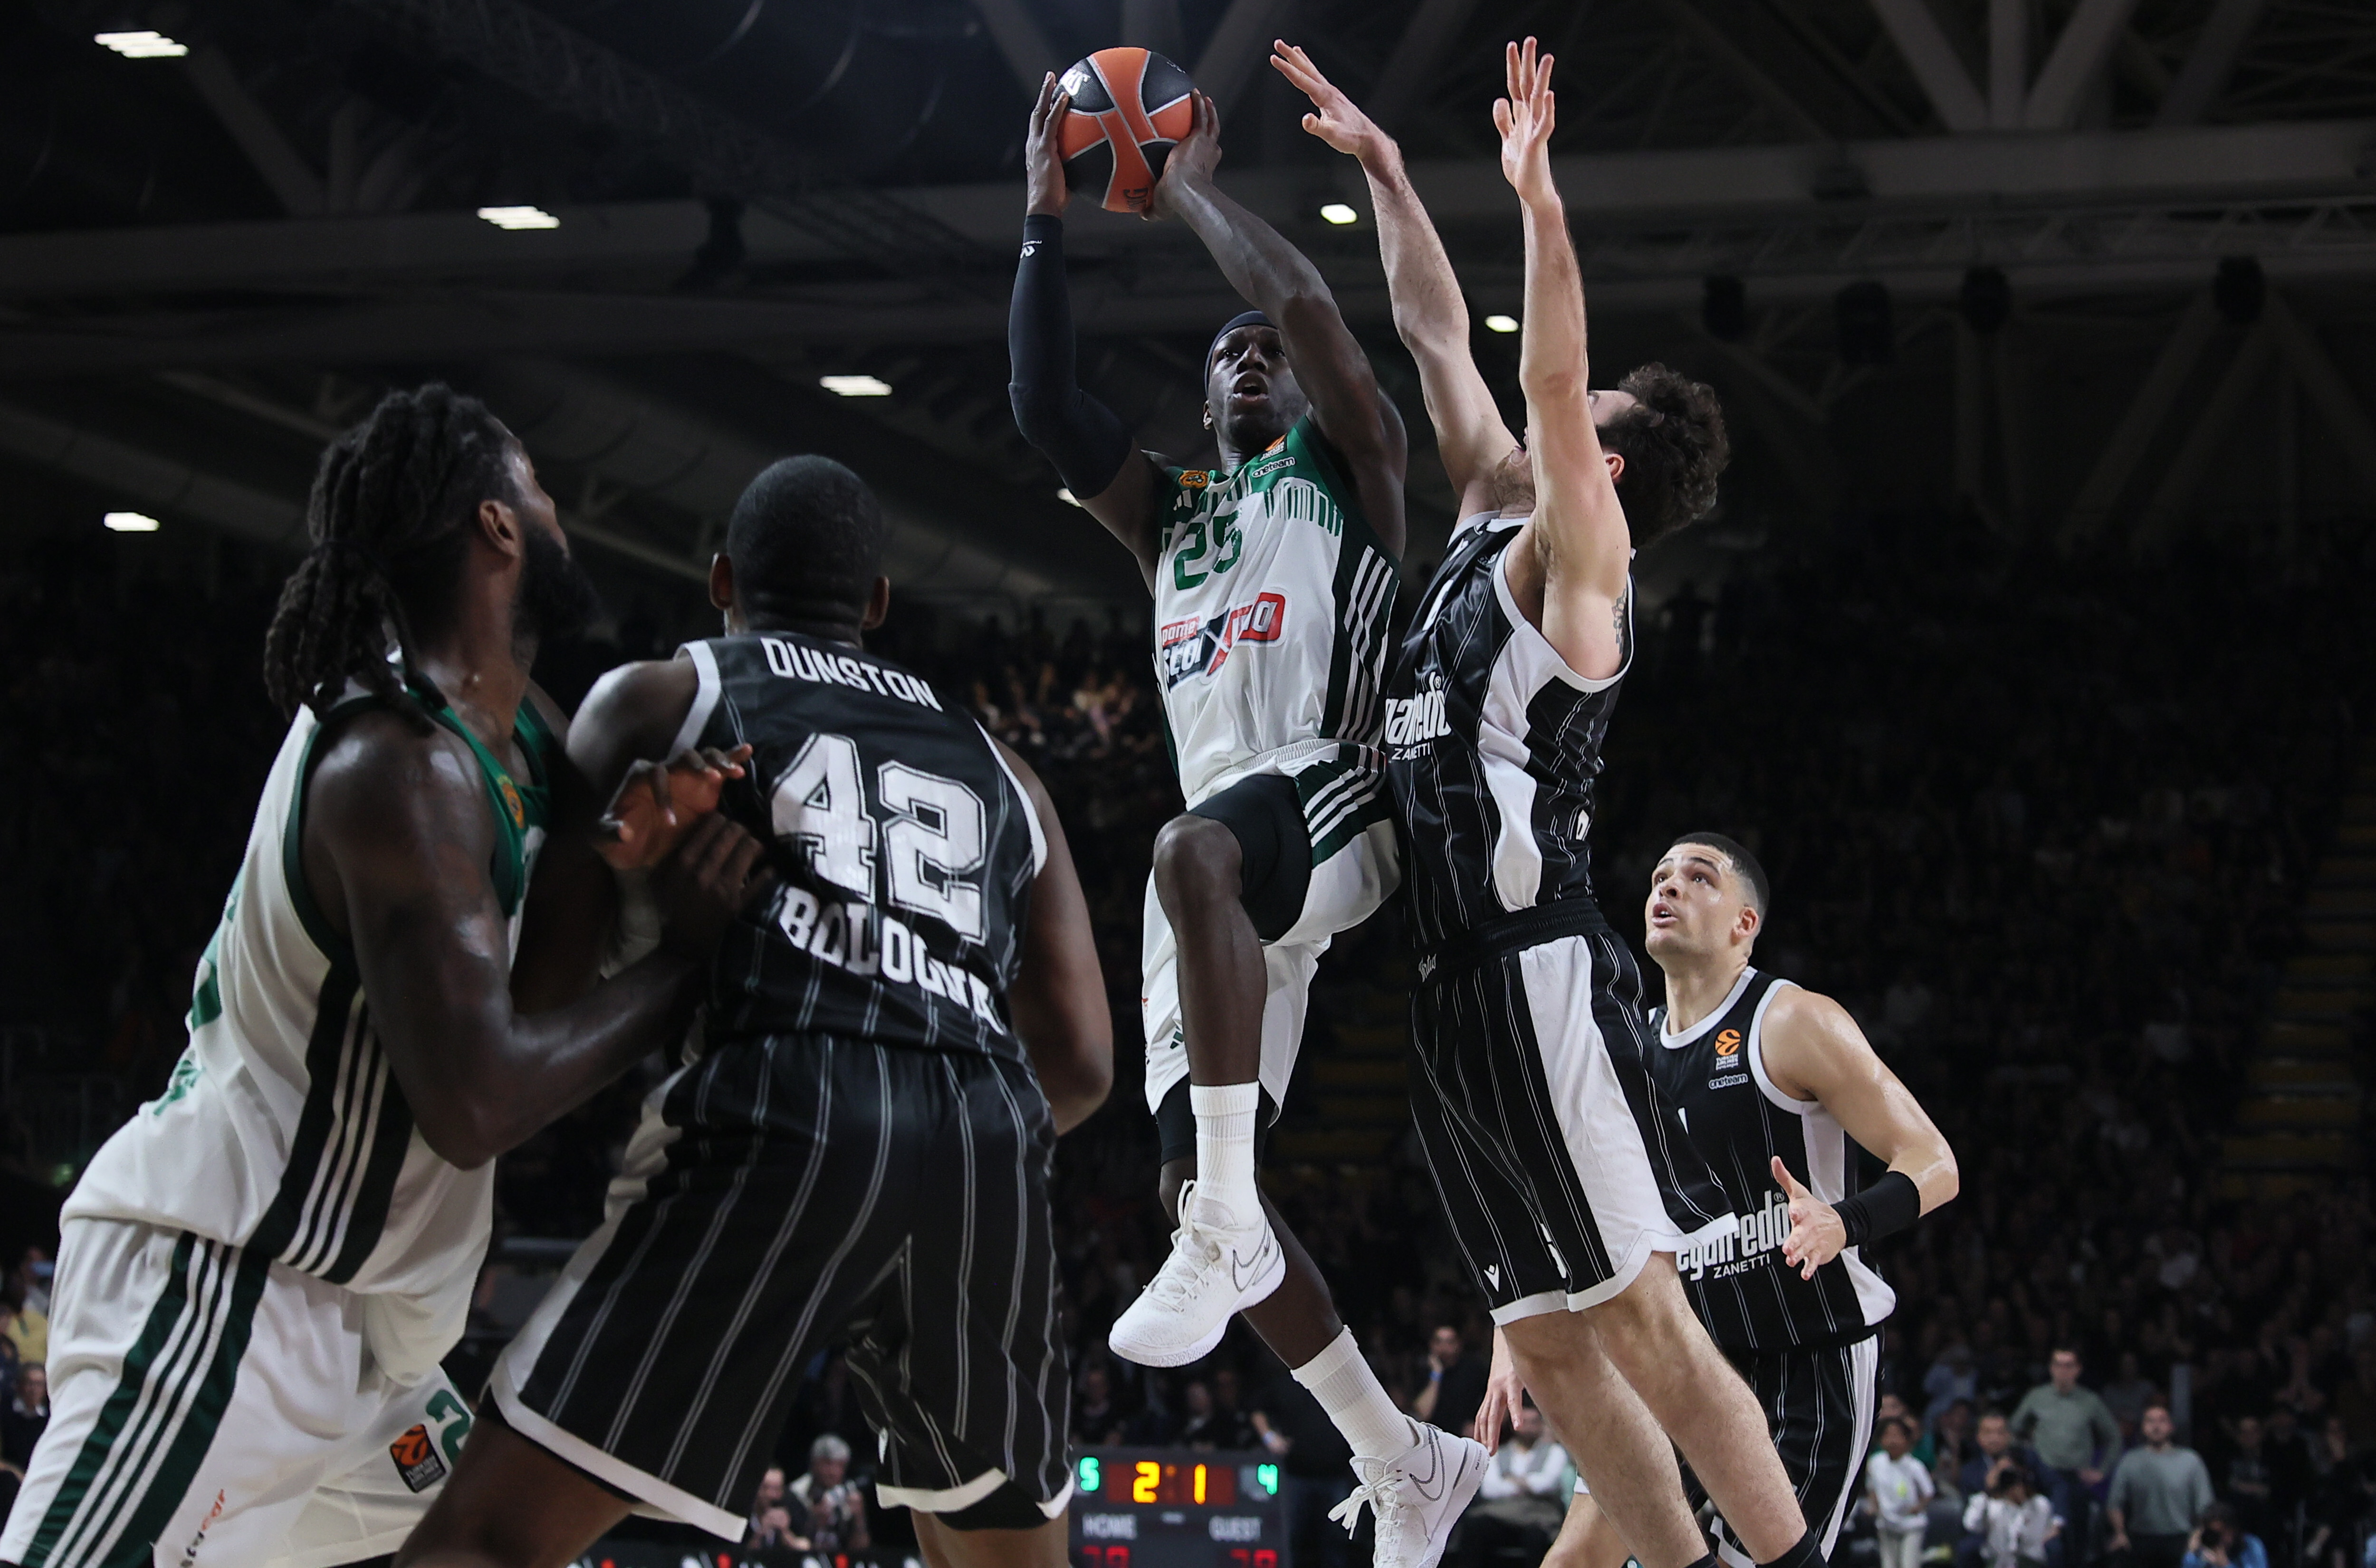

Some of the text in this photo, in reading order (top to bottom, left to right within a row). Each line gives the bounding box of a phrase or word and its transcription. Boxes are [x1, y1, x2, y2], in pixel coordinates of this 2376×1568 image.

[1252, 457, 1296, 478] oneteam
[1174, 510, 1242, 590] 25
[761, 637, 944, 713] DUNSTON
[771, 732, 987, 947] 42
[1708, 1073, 1748, 1090] oneteam
[1713, 1253, 1771, 1280] ZANETTI
[1256, 1463, 1279, 1495] 4
